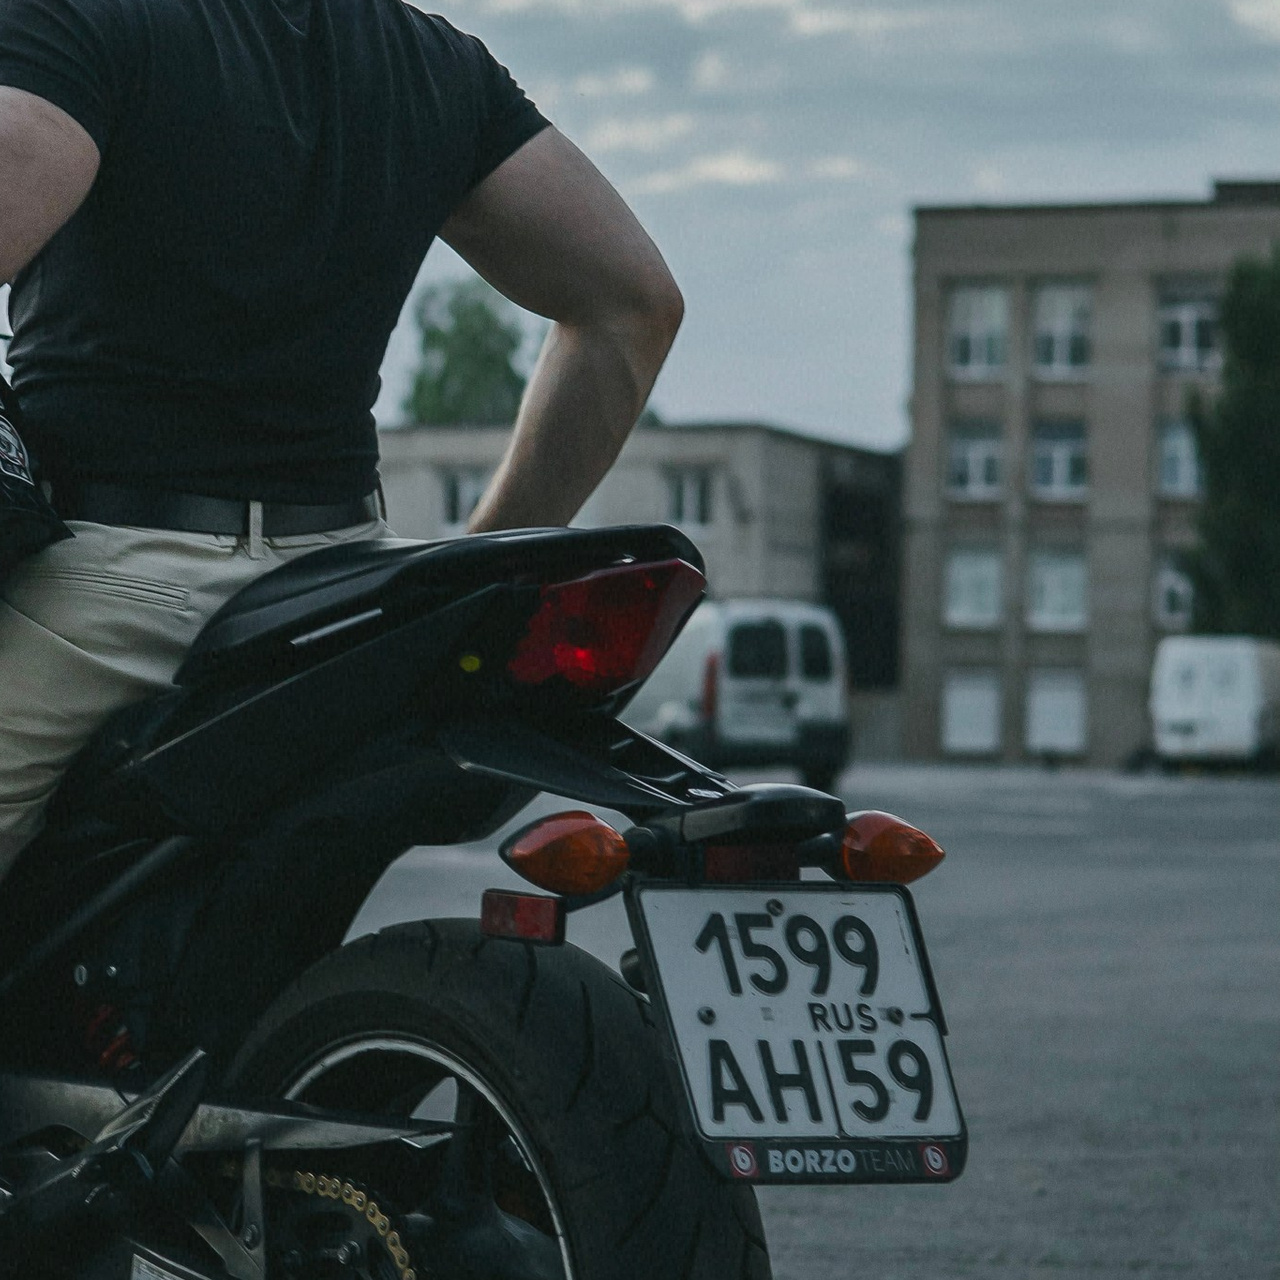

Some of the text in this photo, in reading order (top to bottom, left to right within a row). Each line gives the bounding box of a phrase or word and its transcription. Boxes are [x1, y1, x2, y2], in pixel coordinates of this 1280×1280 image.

[694, 912, 880, 997] 1599
[807, 1001, 878, 1033] RUS
[708, 1038, 934, 1123] AH 59
[768, 1149, 856, 1174] BORZO
[856, 1149, 916, 1172] TEAM
